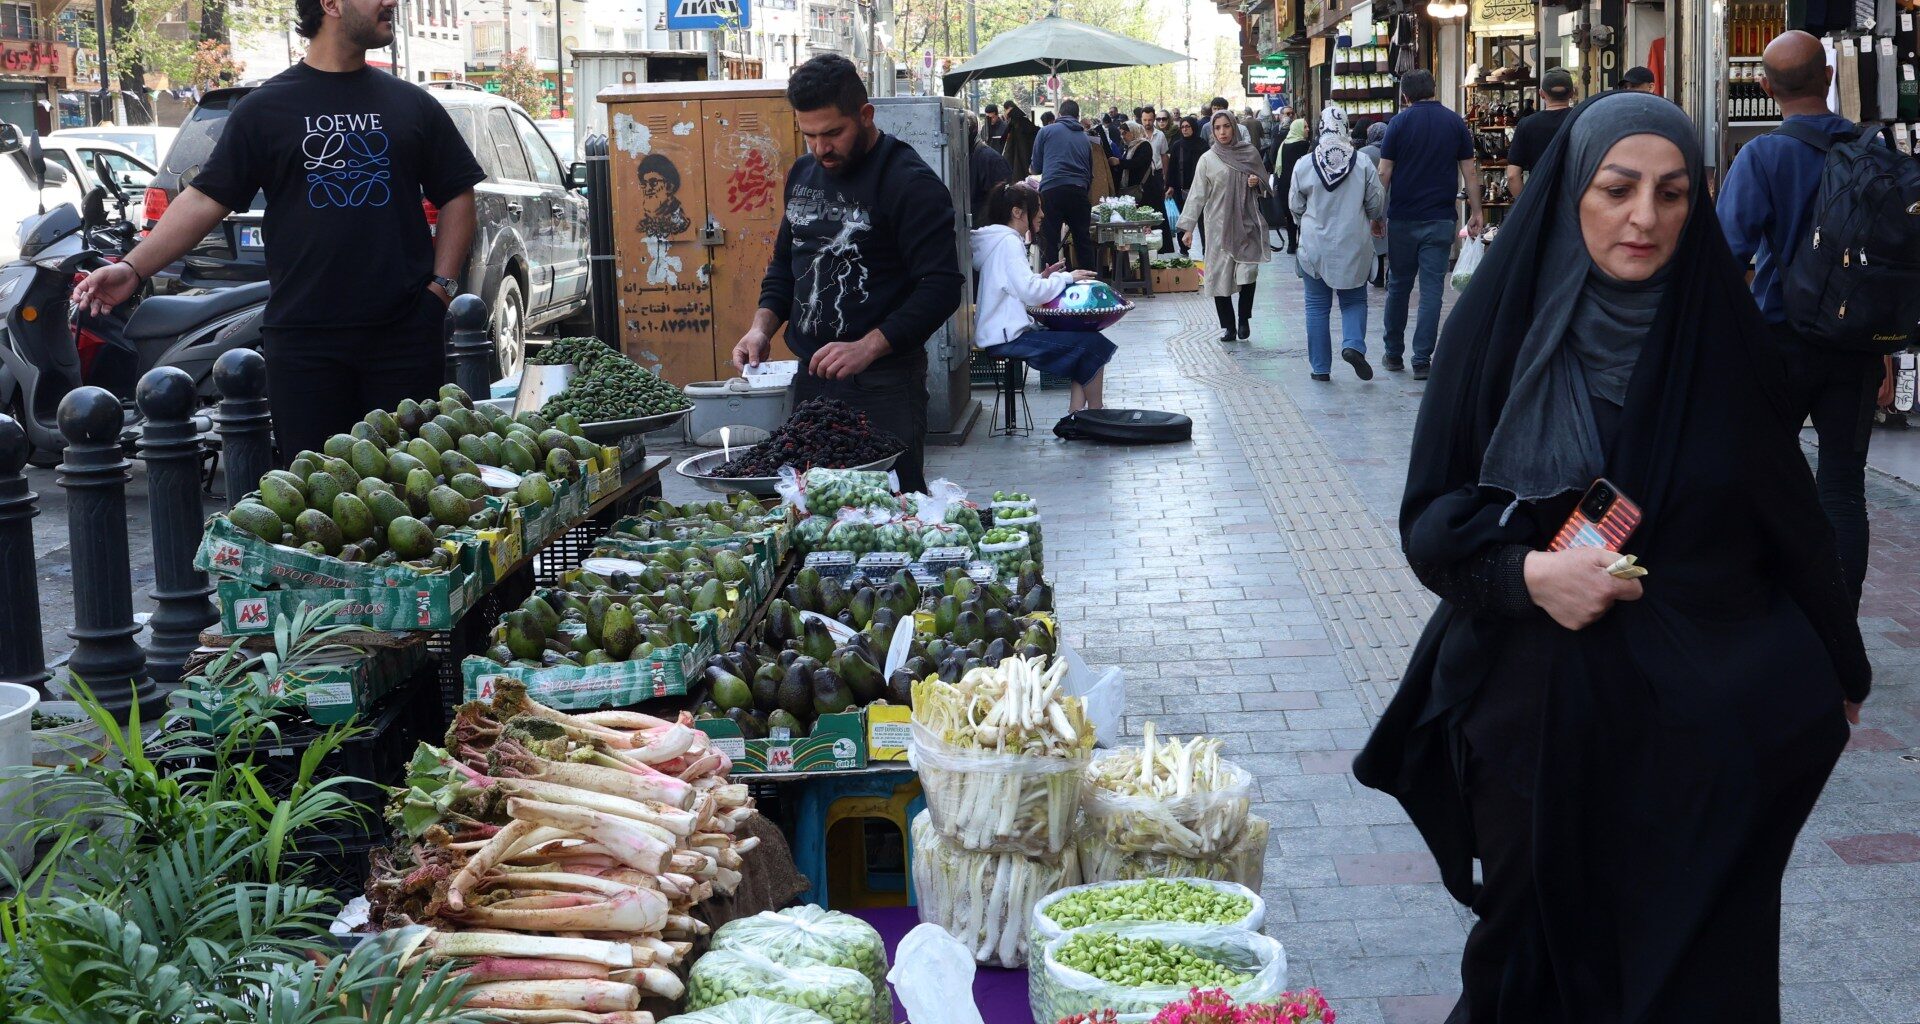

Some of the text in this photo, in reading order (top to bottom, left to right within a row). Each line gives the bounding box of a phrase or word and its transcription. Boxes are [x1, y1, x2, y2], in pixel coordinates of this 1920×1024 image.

[304, 113, 383, 133] LOEWE
[623, 283, 670, 296] پسرانه
[213, 546, 241, 567] AK
[269, 565, 358, 588] AVOCADOS
[238, 603, 268, 624] AK
[769, 750, 793, 767] AK
